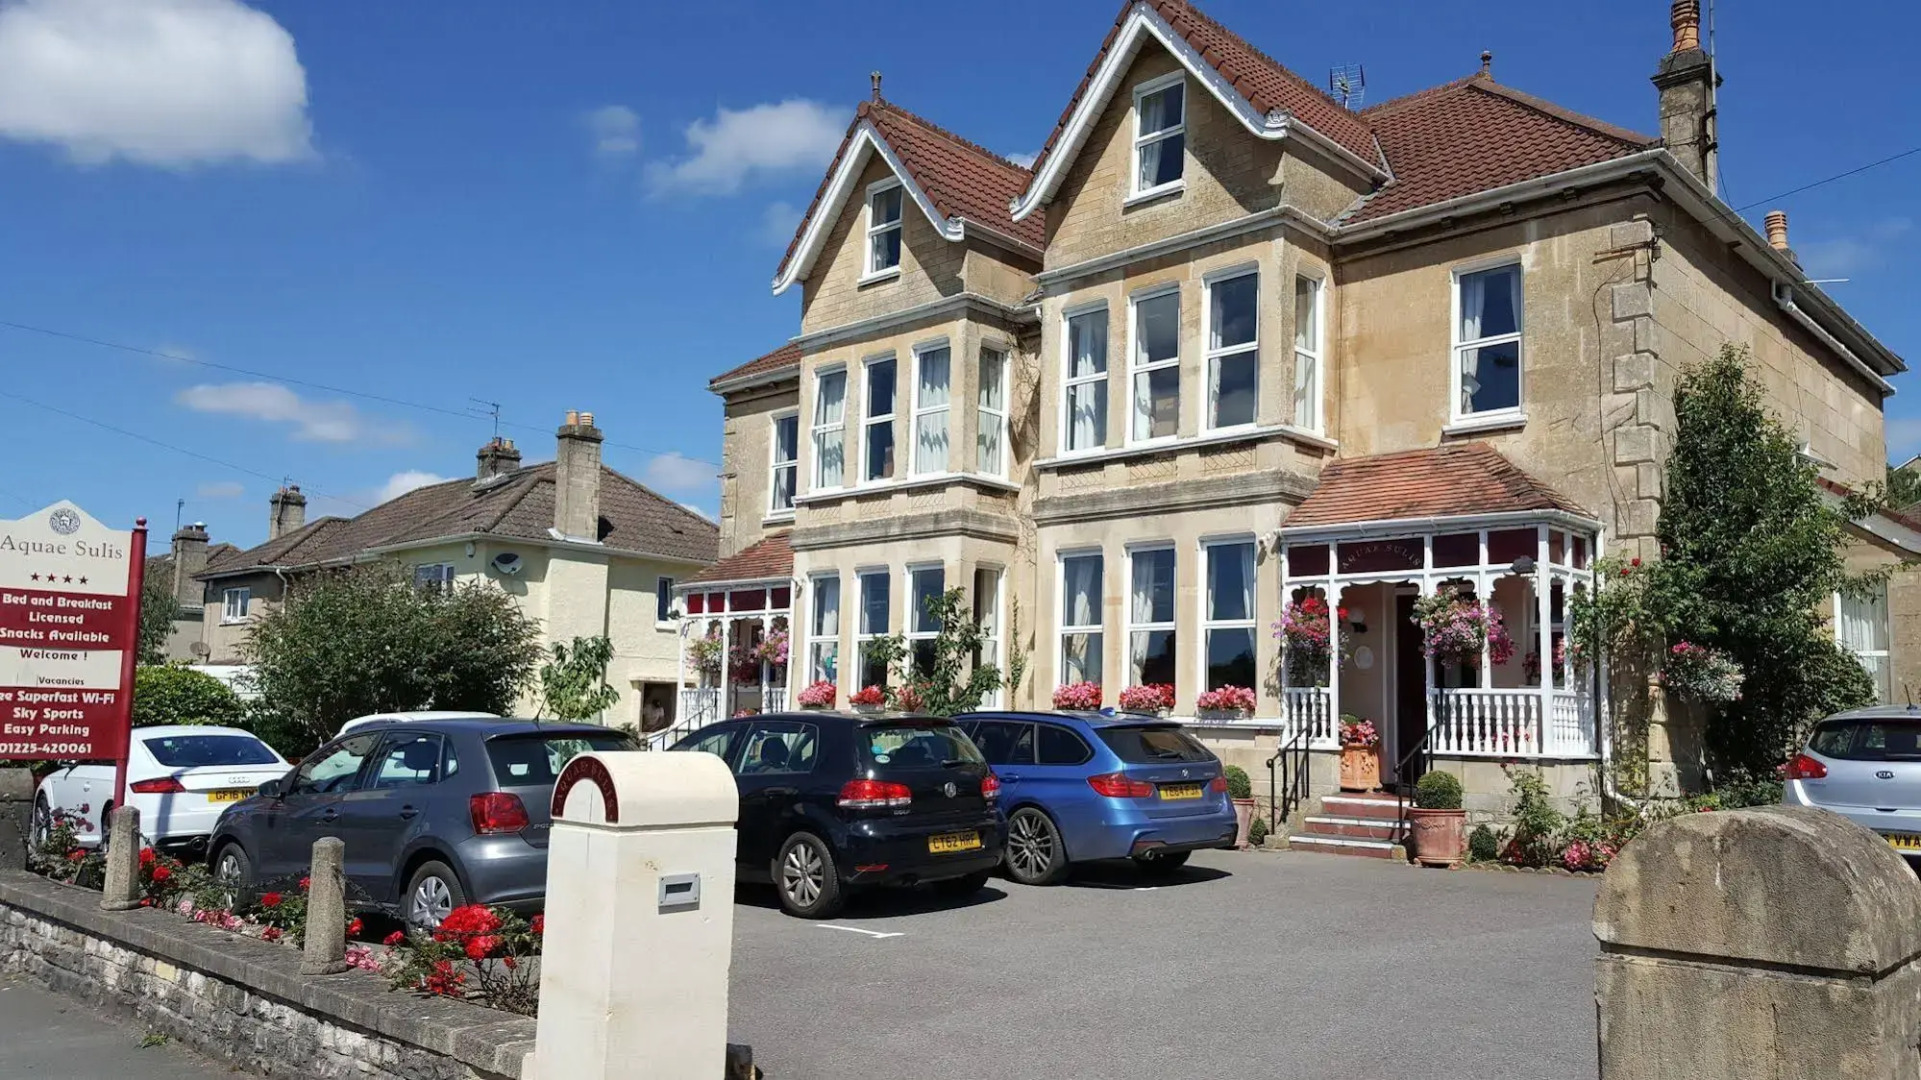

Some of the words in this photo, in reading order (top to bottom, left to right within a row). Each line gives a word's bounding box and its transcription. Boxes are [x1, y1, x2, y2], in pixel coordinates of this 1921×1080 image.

[0, 535, 67, 556] Aquae
[75, 540, 123, 559] Sulis
[3, 593, 27, 605] Bed
[30, 596, 54, 606] and
[57, 597, 113, 610] Breakfast
[29, 611, 84, 624] Licensed
[0, 627, 44, 640] Snacks
[49, 630, 110, 643] Available
[20, 649, 78, 660] Welcome
[39, 676, 85, 685] Vacancies
[17, 690, 79, 703] Superfast
[82, 692, 115, 704] Wi-Fi
[13, 707, 38, 720] Sky
[43, 708, 84, 720] Sports
[4, 723, 35, 736] Easy
[40, 724, 90, 737] Parking
[0, 743, 92, 754] 01225-420061
